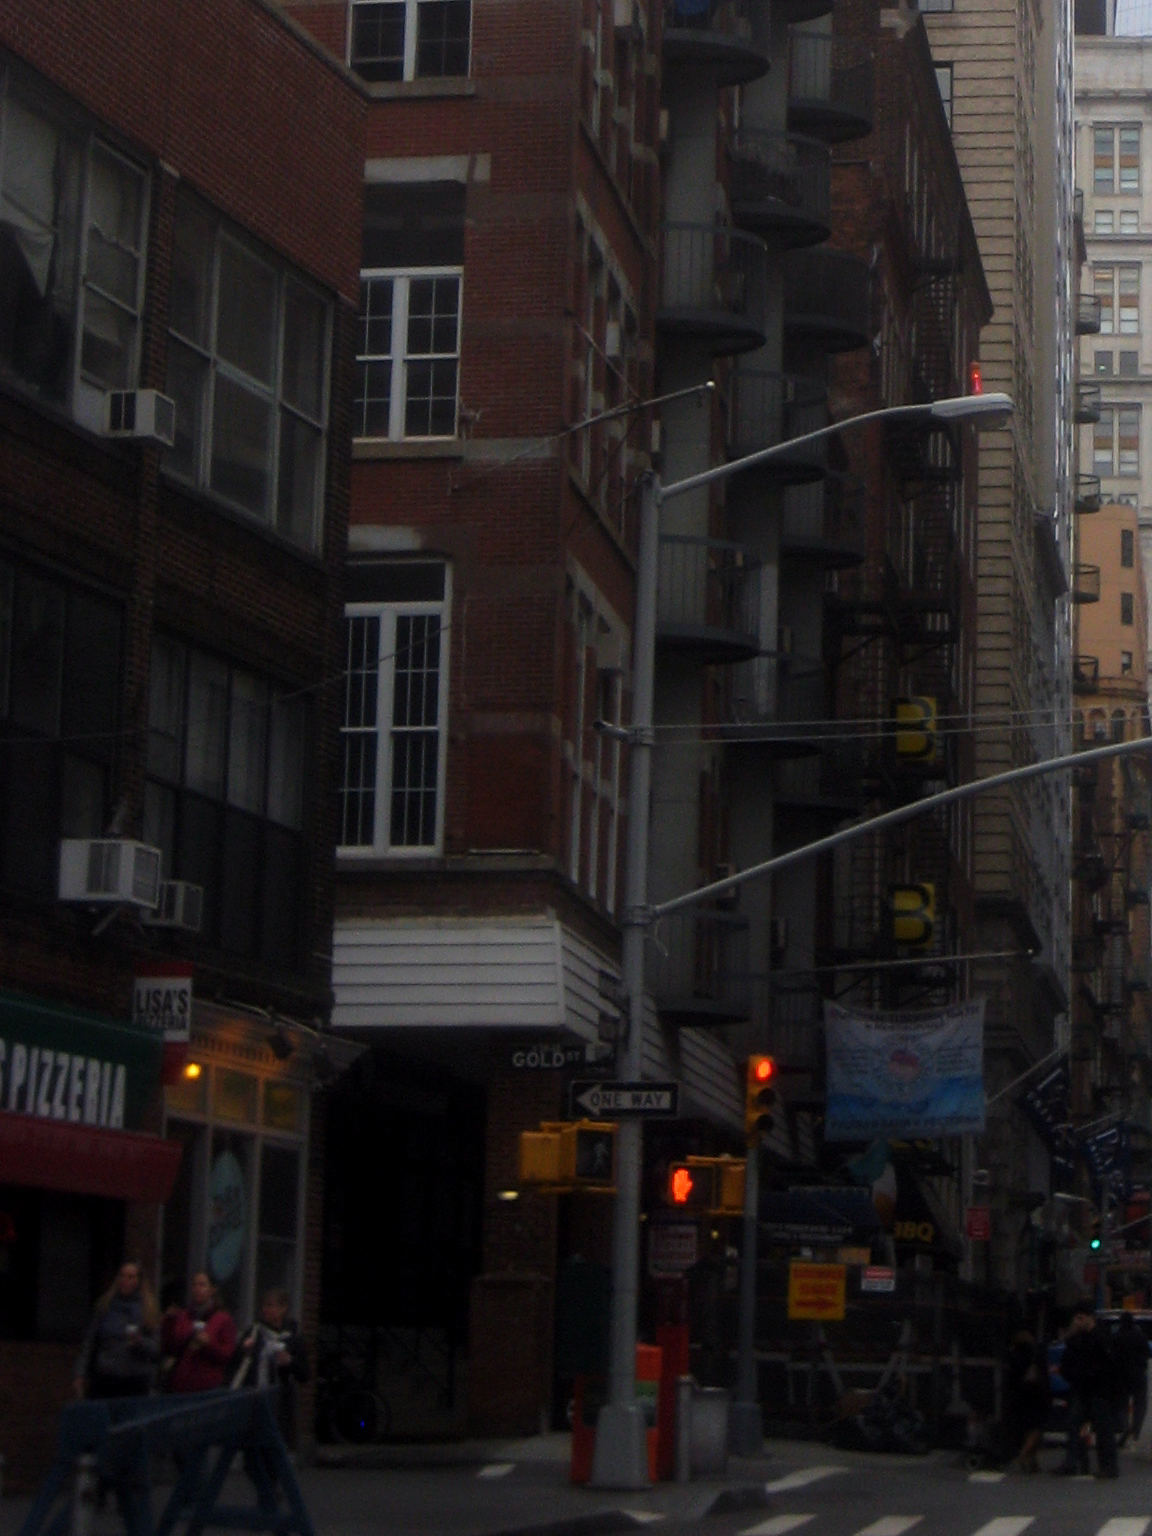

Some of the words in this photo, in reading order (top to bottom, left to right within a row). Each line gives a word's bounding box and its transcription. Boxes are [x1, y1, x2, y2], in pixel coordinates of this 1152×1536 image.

[136, 989, 188, 1014] LISA'S
[512, 1048, 565, 1068] GOLD
[8, 1041, 127, 1130] PIZZERIA
[590, 1090, 622, 1108] ONE
[631, 1090, 663, 1108] WAY
